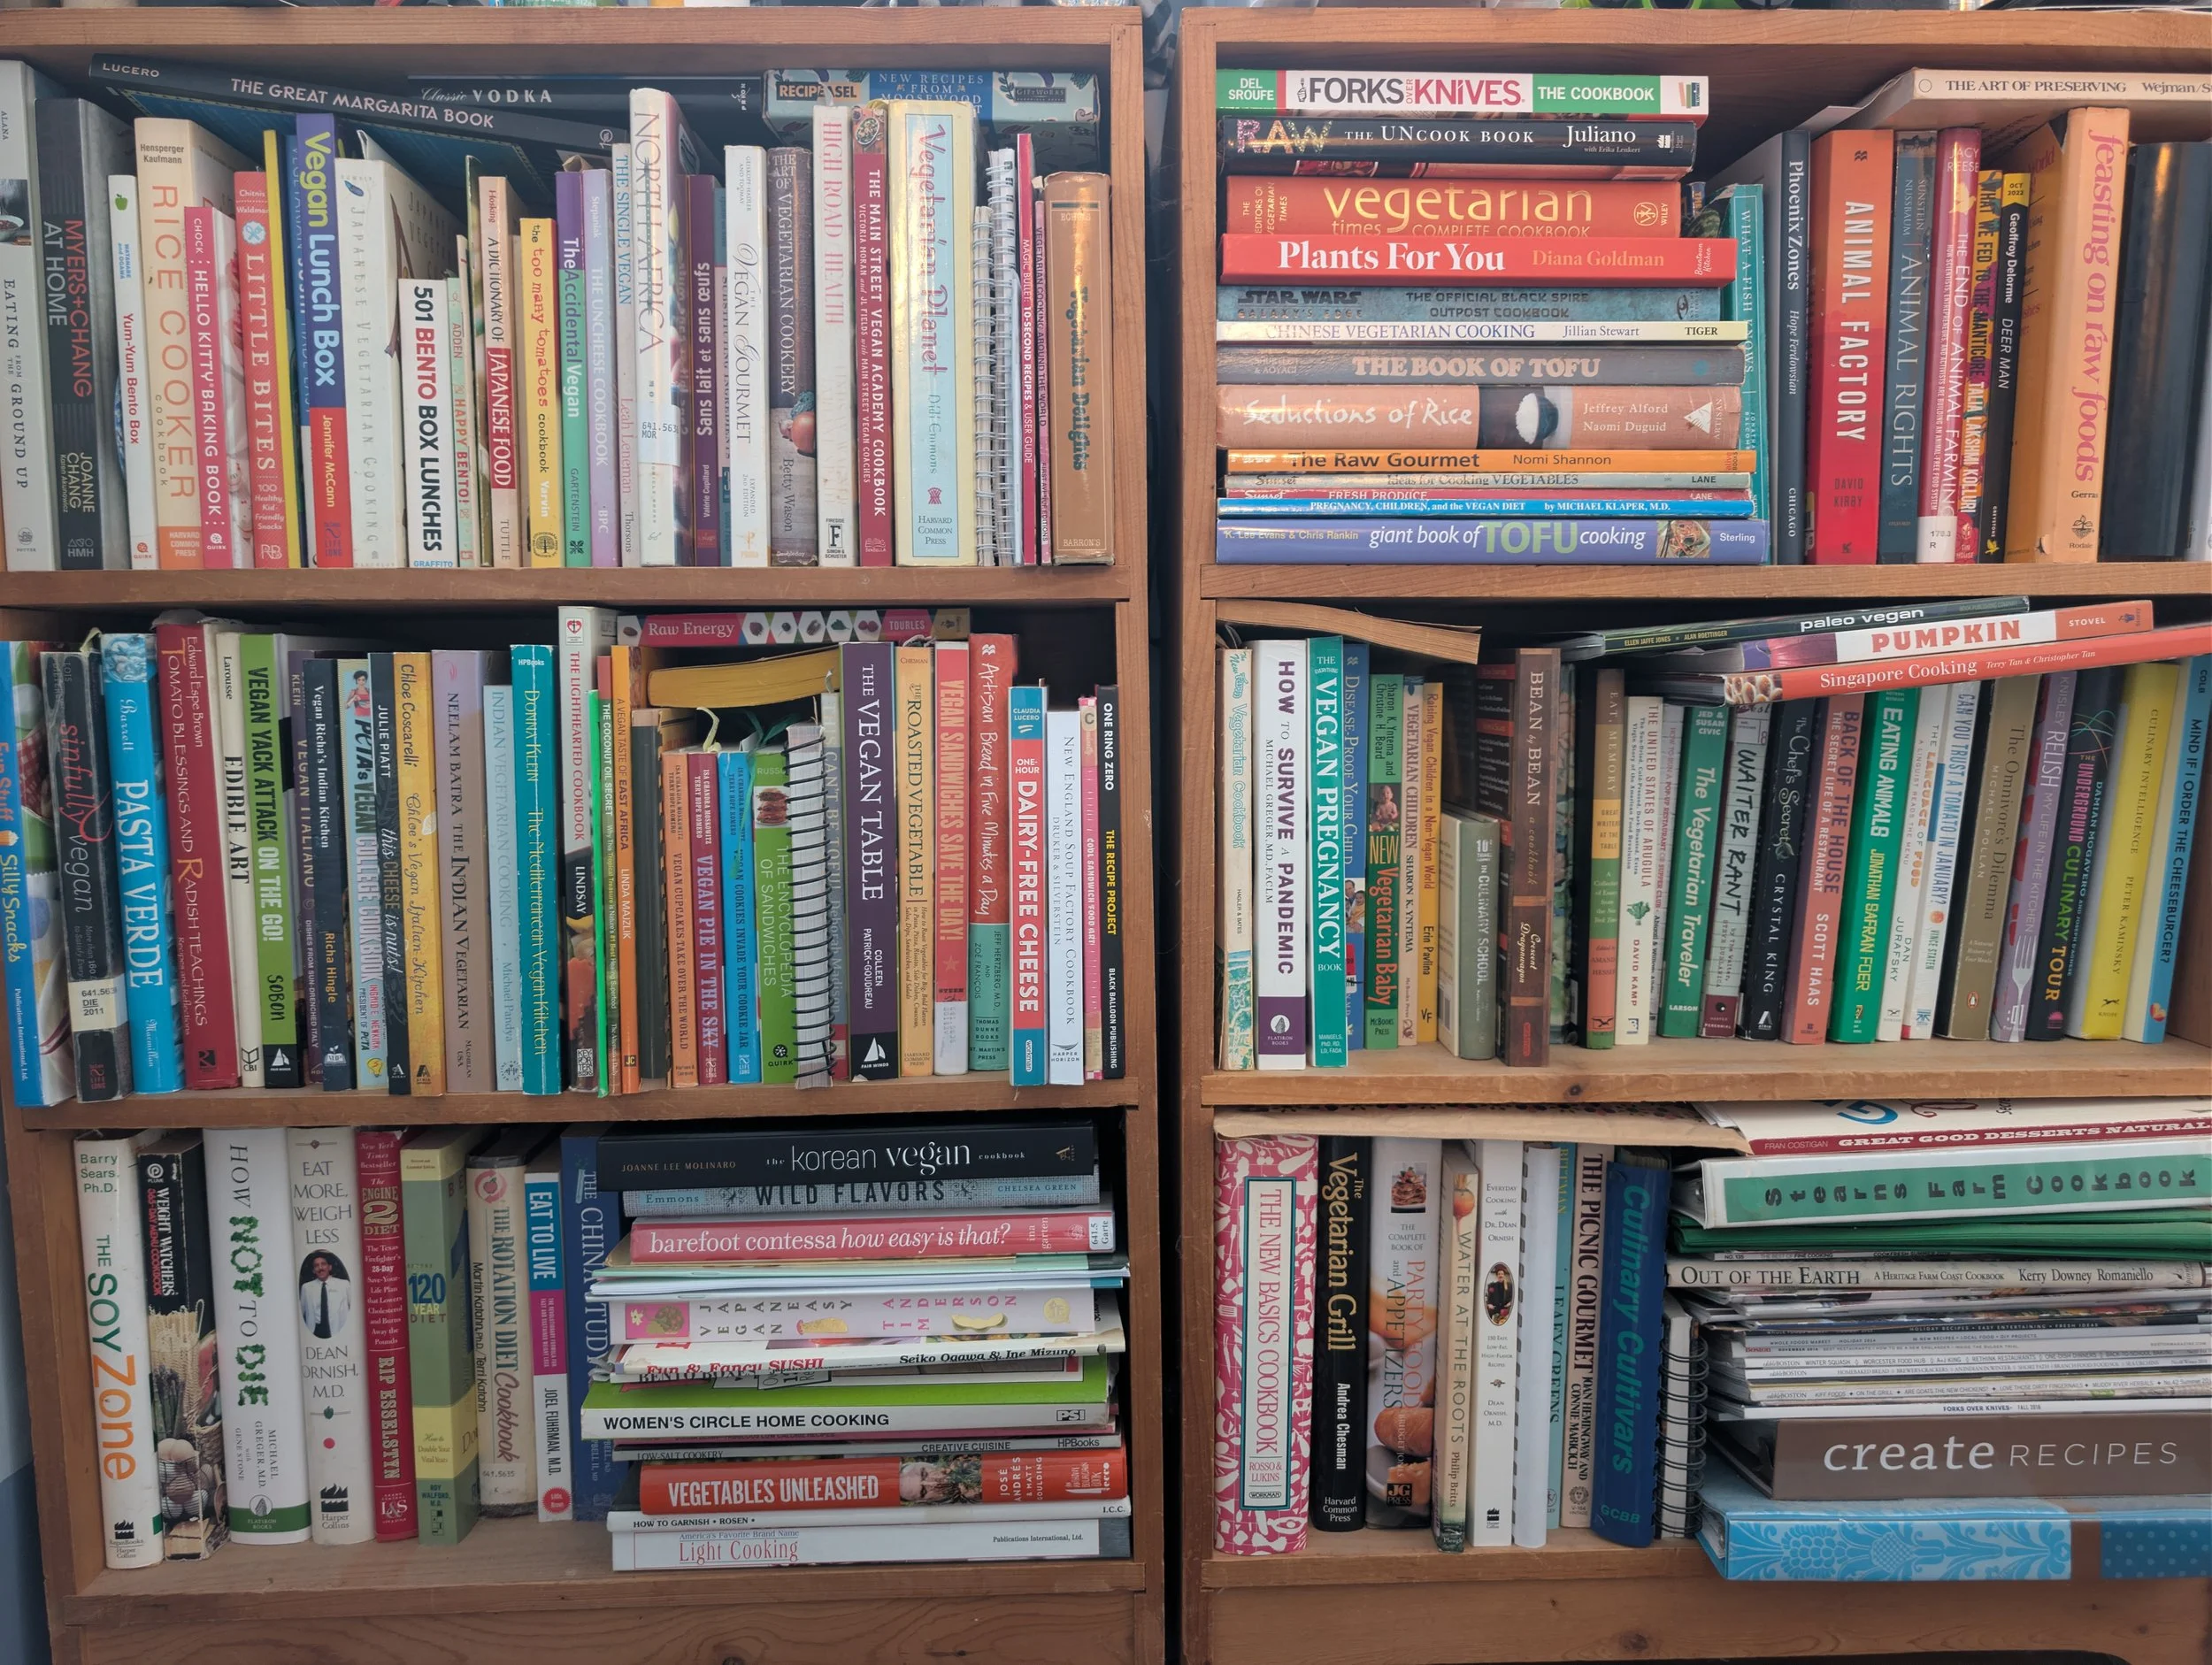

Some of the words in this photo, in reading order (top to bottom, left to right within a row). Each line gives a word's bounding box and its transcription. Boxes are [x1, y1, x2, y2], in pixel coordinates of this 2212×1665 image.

[102, 63, 159, 78] LUCERO
[1240, 79, 1263, 89] DEL
[1946, 80, 1978, 91] THE
[1978, 81, 2007, 92] ART
[2012, 81, 2031, 92] OF
[2034, 81, 2127, 93] PRESERVING
[231, 78, 264, 94] THE
[269, 83, 327, 103] GREAT
[333, 94, 439, 119] MARGARITA
[444, 110, 494, 128] BOOK
[1228, 89, 1274, 101] SROUFE
[1310, 78, 1404, 104] FORKS
[1537, 87, 1566, 100] THE
[1571, 88, 1655, 102] COOKBOOK
[140, 143, 184, 154] Hensperger
[1563, 126, 1635, 148] Juliano
[143, 155, 182, 165] Kaufmann
[300, 131, 331, 228] Vegan
[870, 170, 880, 197] THE
[1788, 159, 1803, 231] Phoenix
[43, 221, 62, 249] AT
[150, 185, 184, 289] RICE
[870, 204, 881, 241] MAIN
[2008, 212, 2021, 259] Geoffroy
[1279, 241, 1379, 270] Plants
[1387, 242, 1440, 270] For
[1445, 243, 1504, 271] You
[1532, 250, 1582, 265] Diana
[1586, 250, 1664, 267] Goldman
[1788, 235, 1801, 291] Zones
[1842, 201, 1873, 303] ANIMAL
[46, 257, 67, 326] HOME
[310, 233, 340, 323] Lunch
[871, 248, 881, 302] STREET
[2004, 261, 2016, 303] Delorme
[65, 219, 93, 398] MYERS+CHANG
[244, 254, 269, 368] LITTLE
[413, 287, 434, 322] 501
[122, 313, 138, 372] Yum-Yum
[871, 310, 883, 357] VEGAN
[1563, 324, 1597, 339] Jillian
[1600, 325, 1640, 337] Stewart
[2001, 318, 2013, 354] DEER
[313, 330, 340, 386] Box
[415, 327, 437, 400] BENTO
[1998, 357, 2009, 388] MAN
[125, 376, 138, 415] Bento
[872, 362, 885, 432] ACADEMY
[1835, 321, 1869, 441] FACTORY
[157, 310, 196, 497] COOKER
[1584, 403, 1625, 417] Jeffrey
[1630, 402, 1668, 415] Alford
[129, 419, 140, 444] Box
[253, 380, 277, 471] BITES
[322, 415, 334, 460] Jennifer
[418, 405, 439, 449] BOX
[1584, 421, 1620, 433] Naomi
[1624, 420, 1666, 435] Duguid
[783, 458, 794, 491] Betty
[1513, 454, 1547, 465] Nomi
[1552, 454, 1611, 465] Shannon
[66, 452, 80, 509] CHANG
[80, 451, 96, 512] JOANNE
[325, 462, 335, 508] McCann
[873, 440, 887, 517] COOKBOOK
[420, 457, 442, 551] LUNCHES
[784, 495, 794, 533] Wason
[918, 514, 953, 524] HARVARD
[1311, 502, 1373, 512] PREGNANCY,
[1376, 502, 1430, 512] CHILDREN,
[1432, 502, 1448, 510] and
[1450, 502, 1463, 510] the
[1466, 502, 1500, 510] VEGAN
[1502, 502, 1525, 510] DIET
[1545, 502, 1554, 513] by
[1556, 502, 1601, 511] MICHAEL
[1606, 503, 1647, 511] KLAPER,
[1650, 503, 1671, 511] M.D.
[918, 526, 953, 534] COMMON
[925, 536, 946, 545] PRESS
[648, 622, 680, 636] Raw
[684, 622, 734, 640] Energy
[1800, 615, 1855, 632] paleo
[1861, 607, 1924, 627] vegan
[1871, 619, 2021, 654] PUMPKIN
[2069, 617, 2106, 628] STOVEL
[223, 656, 233, 700] Larousse
[862, 664, 874, 697] THE
[1277, 660, 1295, 714] HOW
[1820, 669, 1904, 691] Singapore
[1909, 659, 1978, 680] Cooking
[378, 706, 389, 740] JULIE
[1279, 721, 1290, 740] TO
[1315, 678, 1338, 779] VEGAN
[379, 744, 391, 778] PIATT
[858, 699, 880, 804] VEGAN
[225, 756, 246, 833] EDIBLE
[1276, 748, 1294, 840] SURVIVE
[116, 779, 154, 874] PASTA
[229, 841, 250, 884] ART
[861, 810, 884, 900] TABLE
[1017, 780, 1039, 917] DAIRY-FREE
[1280, 848, 1289, 856] A
[1316, 787, 1340, 959] PREGNANCY
[124, 882, 163, 988] VERDE
[1278, 863, 1295, 975] PANDEMIC
[1018, 923, 1039, 1013] CHEESE
[1317, 963, 1342, 972] BOOK
[80, 1154, 118, 1168] Barry
[303, 1161, 331, 1177] EAT
[766, 1157, 784, 1166] the
[792, 1146, 877, 1172] korean
[886, 1142, 971, 1175] vegan
[979, 1151, 1025, 1162] cookbook
[83, 1183, 118, 1194] Ph.D.
[294, 1183, 349, 1200] MORE,
[295, 1204, 352, 1222] WEIGH
[1259, 1189, 1282, 1228] THE
[306, 1229, 340, 1244] LESS
[649, 1226, 741, 1254] barefoot
[746, 1231, 837, 1252] contessa
[841, 1227, 885, 1249] how
[888, 1229, 934, 1254] easy
[937, 1226, 952, 1246] is
[957, 1224, 1011, 1246] that?
[1258, 1233, 1282, 1276] NEW
[1680, 1267, 1725, 1285] OUT
[1730, 1268, 1751, 1285] OF
[1757, 1270, 1793, 1285] THE
[1798, 1267, 1863, 1285] EARTH
[1257, 1279, 1282, 1346] BASICS
[1256, 1349, 1282, 1453] COOKBOOK
[603, 1416, 684, 1431] WOMEN'S
[689, 1415, 750, 1429] CIRCLE
[756, 1414, 806, 1428] HOME
[810, 1413, 889, 1428] COOKING
[1823, 1436, 1995, 1472] create
[2009, 1442, 2177, 1466] RECIPES
[667, 1478, 776, 1507] VEGETABLES
[780, 1475, 879, 1502] UNLEASHED
